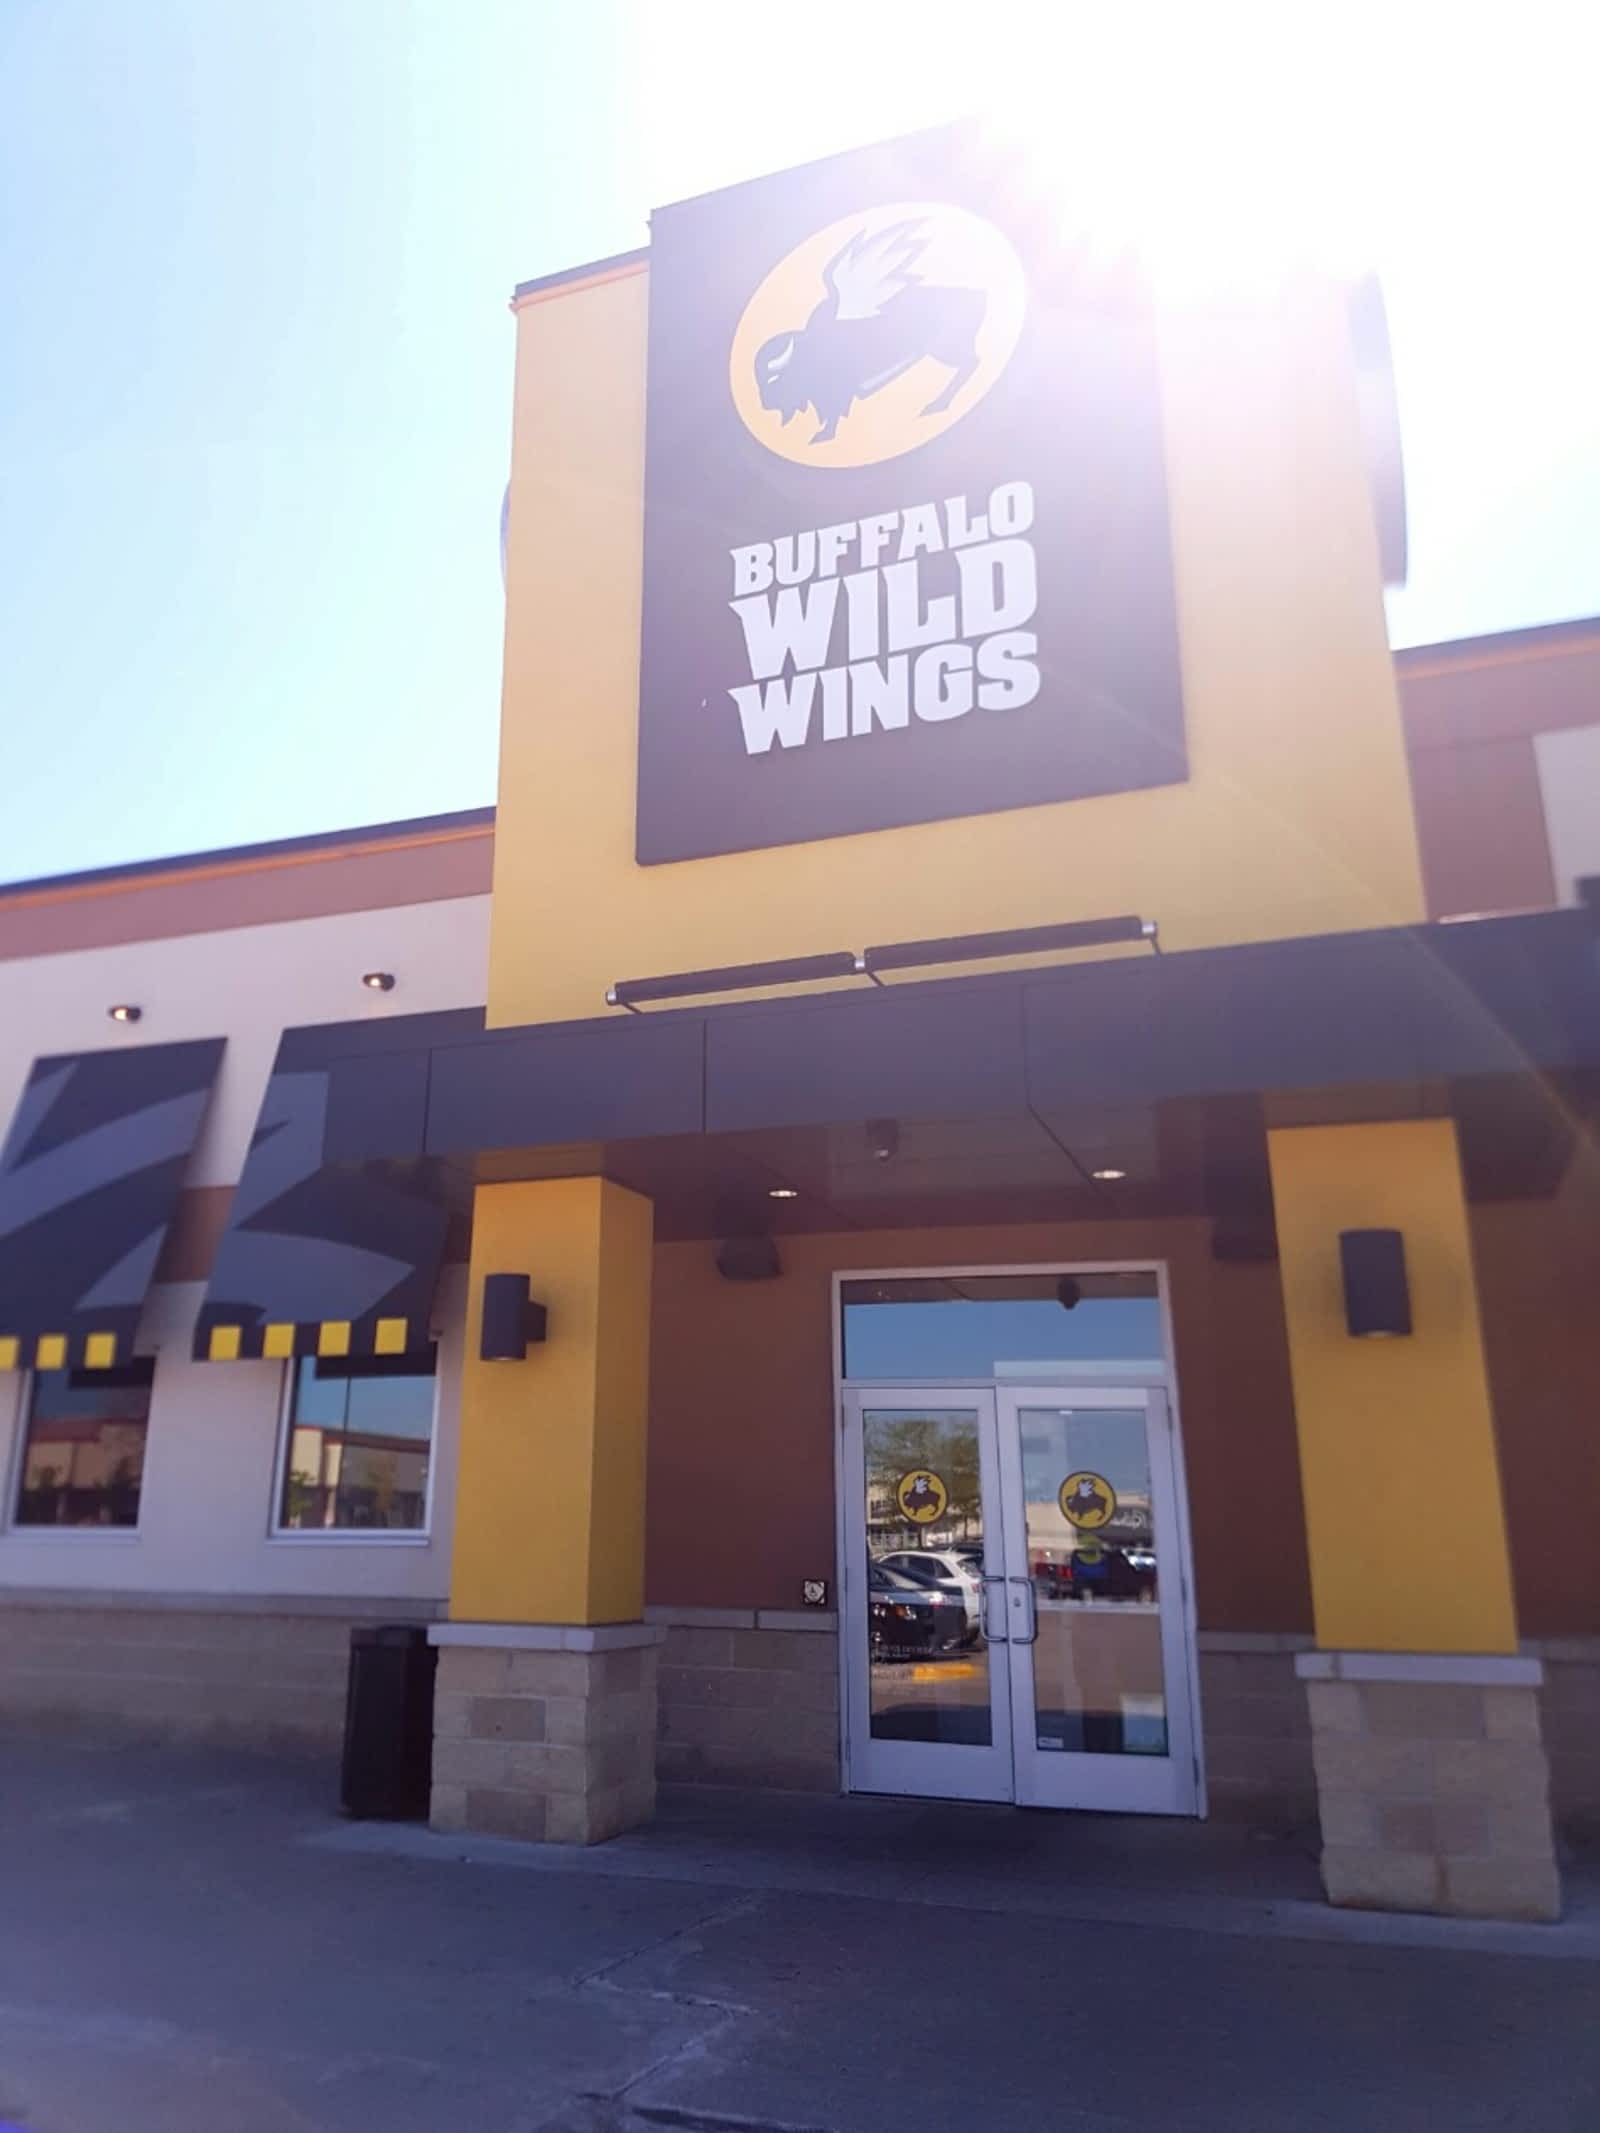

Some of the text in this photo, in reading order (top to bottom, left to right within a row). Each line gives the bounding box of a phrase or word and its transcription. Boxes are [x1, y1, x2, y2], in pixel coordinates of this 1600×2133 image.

[729, 481, 1035, 597] BUFFALO
[728, 539, 1038, 681] WILD
[727, 632, 1041, 755] WINGS
